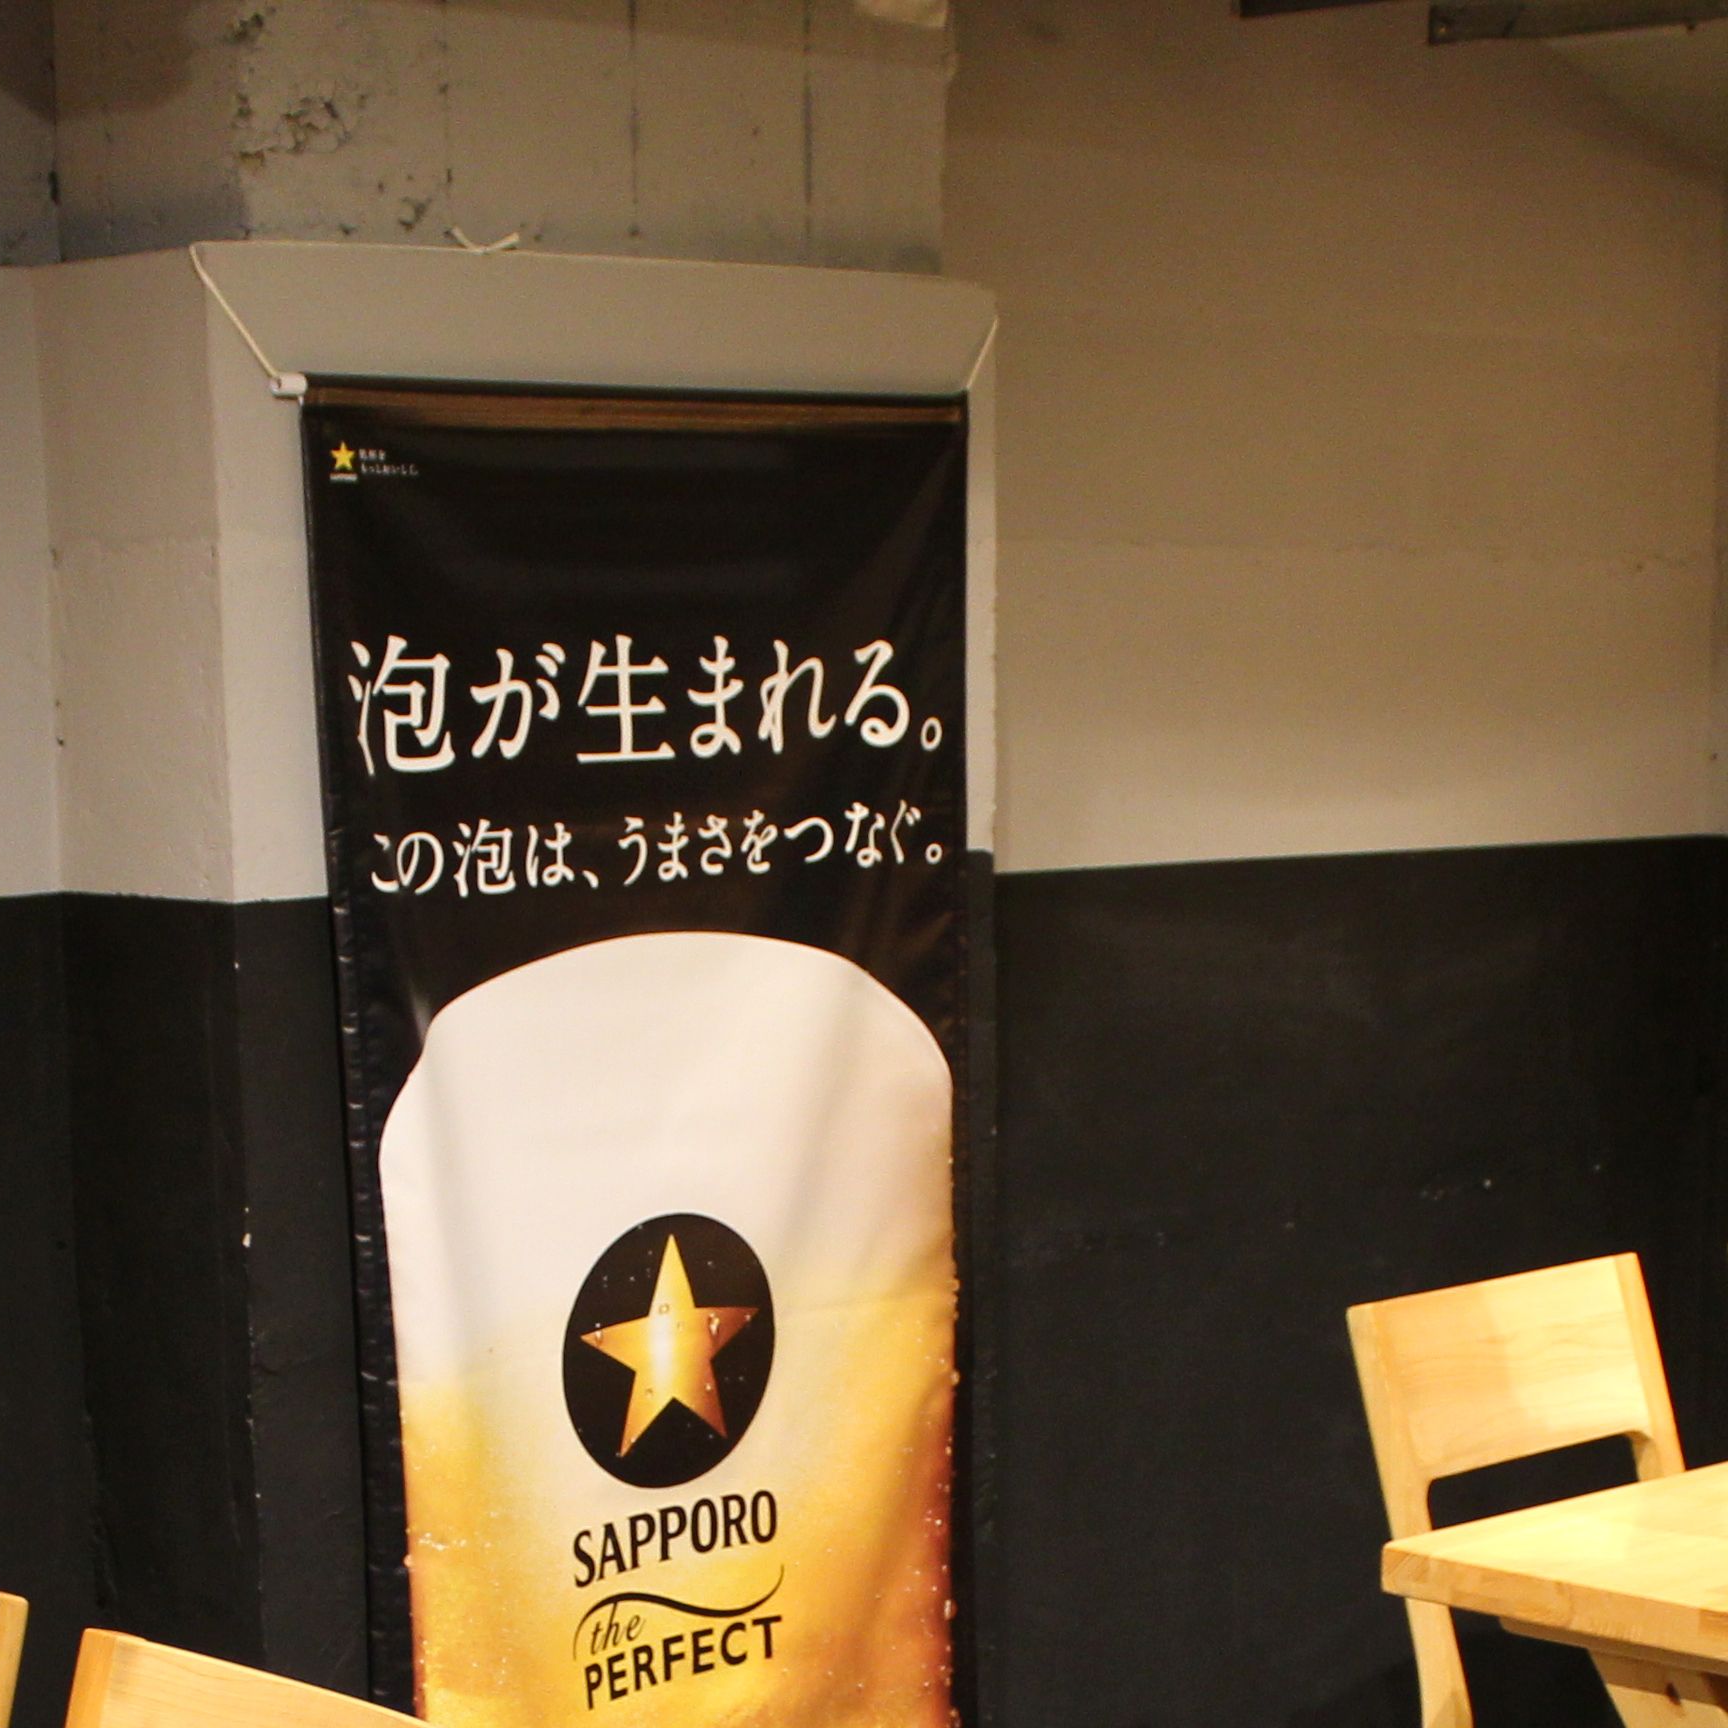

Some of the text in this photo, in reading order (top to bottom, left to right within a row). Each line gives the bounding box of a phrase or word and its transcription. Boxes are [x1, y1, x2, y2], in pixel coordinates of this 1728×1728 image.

[348, 633, 943, 777] 泡が生まれる。
[371, 799, 945, 899] この泡は、うまさをつなぐ。
[572, 1489, 778, 1589] SAPPORO
[584, 1615, 783, 1711] PERFECT
[590, 1602, 646, 1656] the
